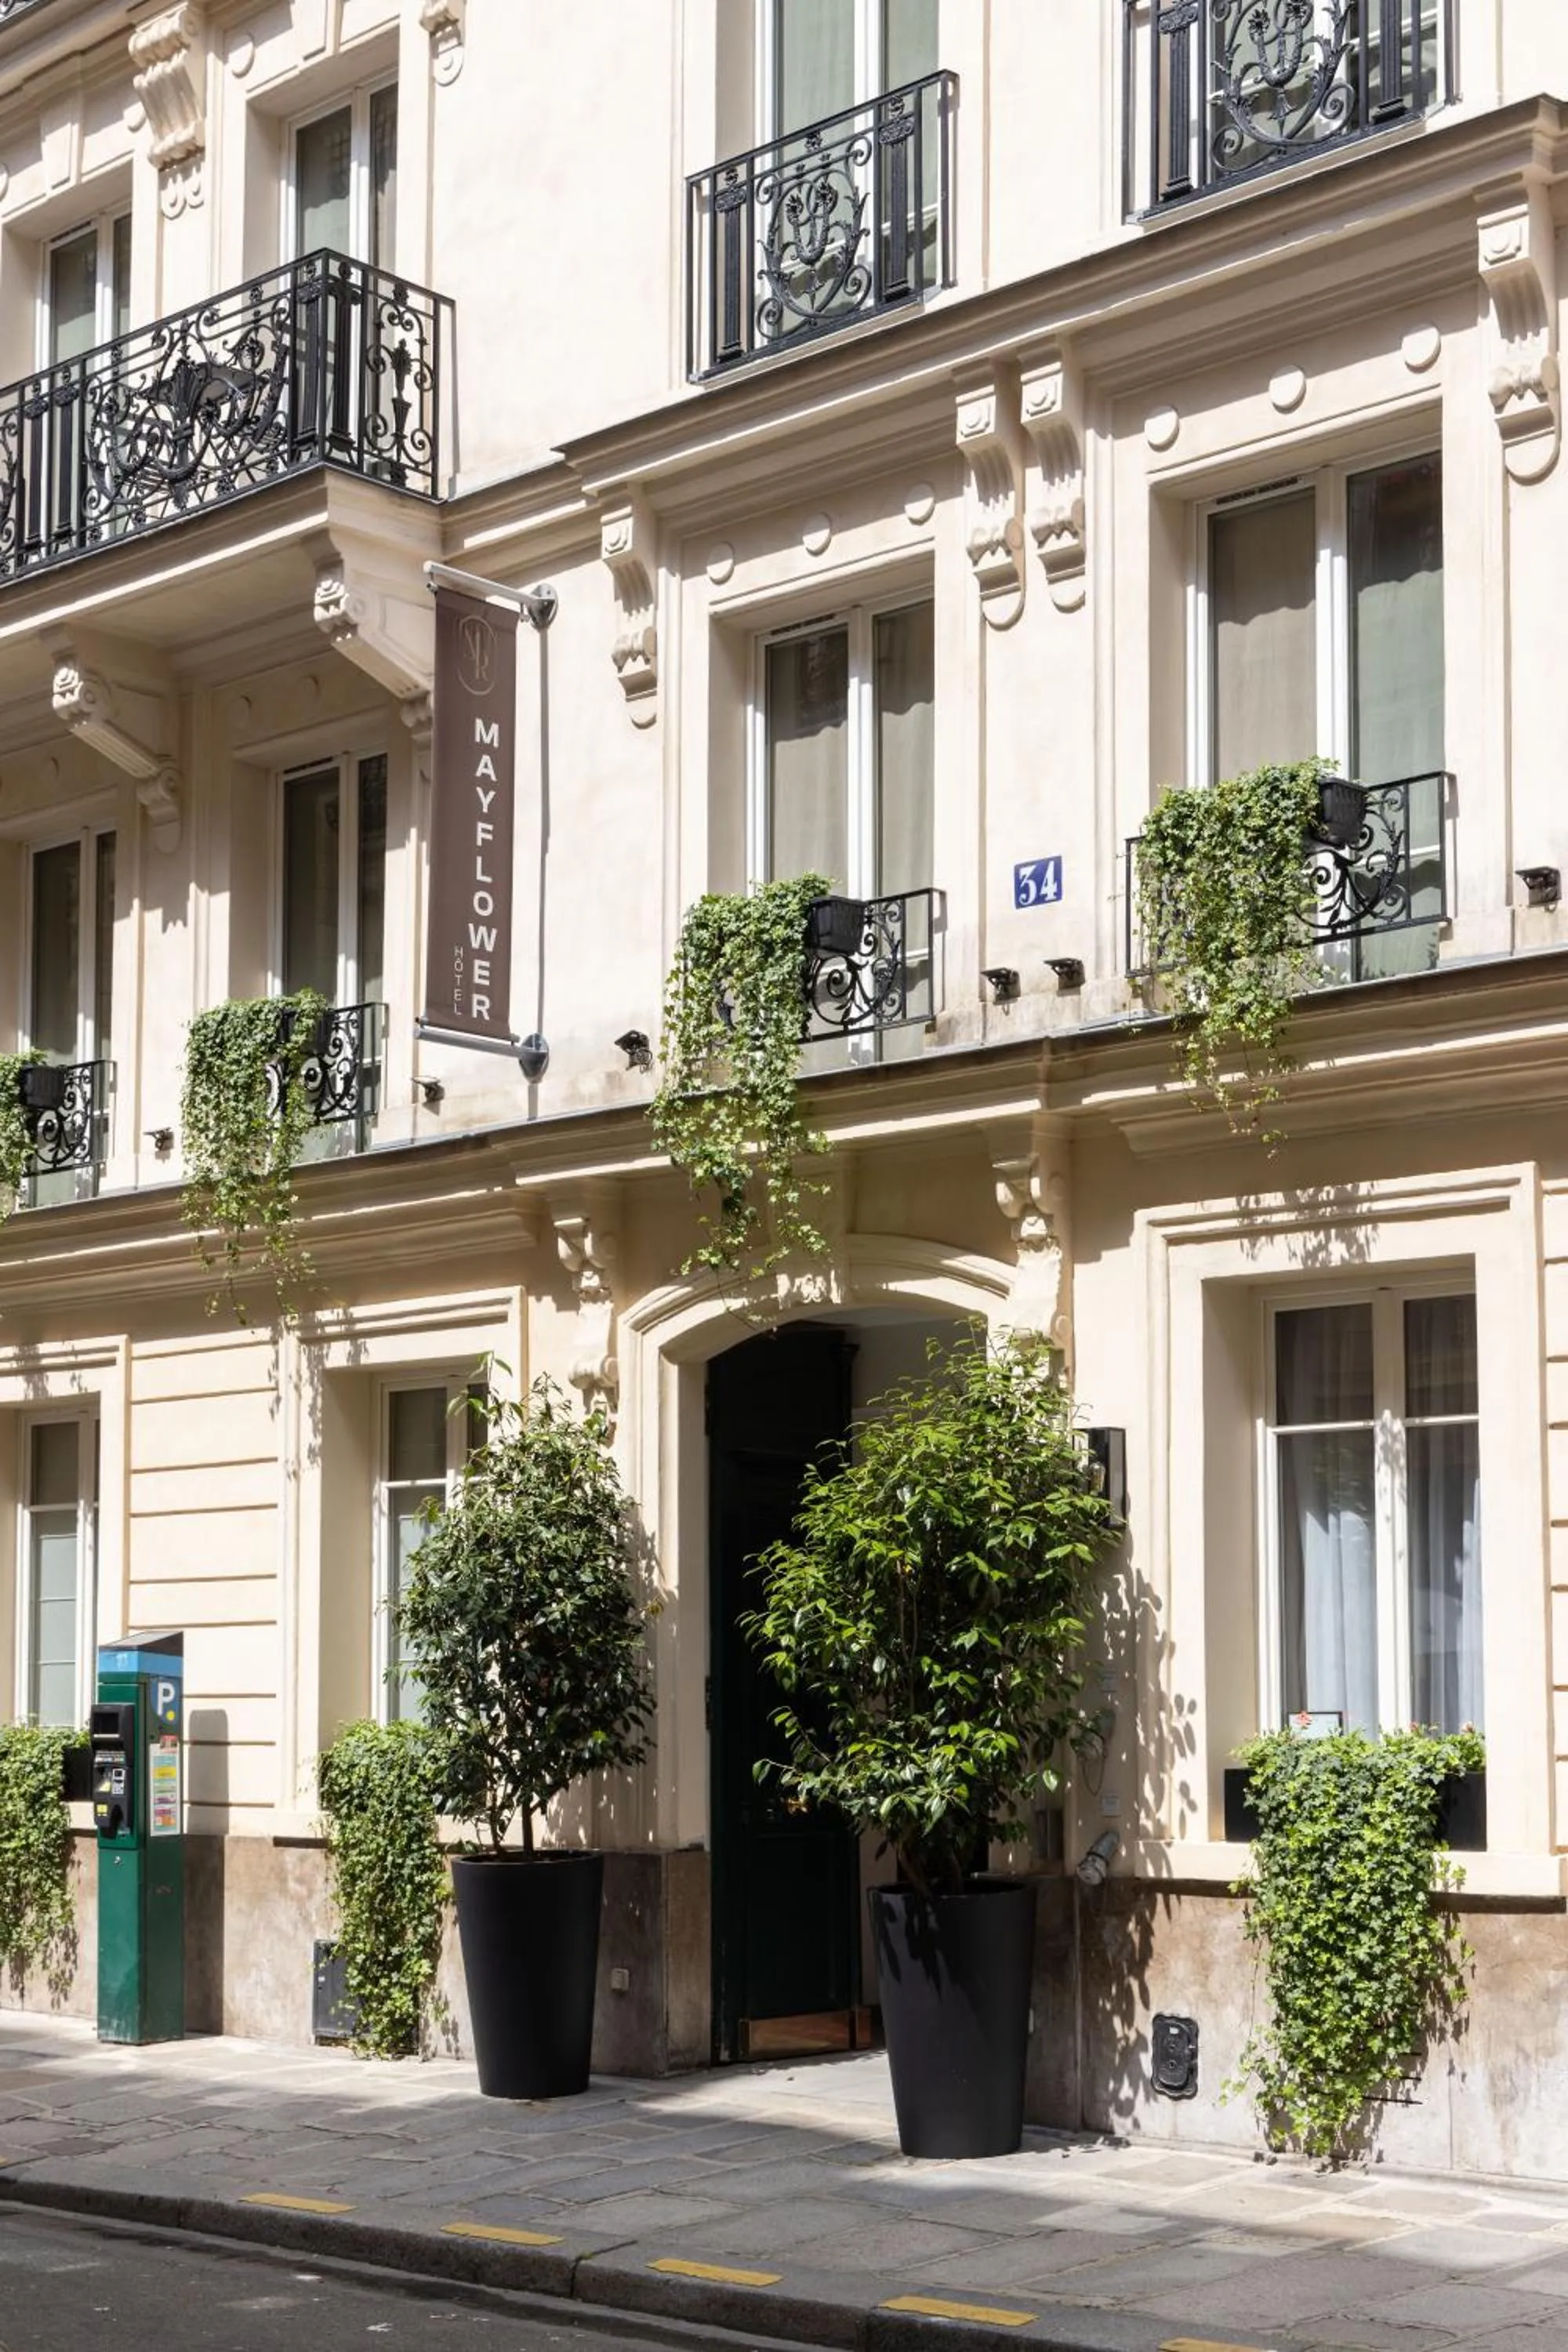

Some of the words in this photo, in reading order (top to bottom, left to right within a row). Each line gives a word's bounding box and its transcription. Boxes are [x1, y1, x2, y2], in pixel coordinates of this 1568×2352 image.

[468, 717, 499, 1021] MAYFLOWER
[1019, 860, 1057, 905] 34
[454, 945, 463, 1015] HÔTEL
[158, 1682, 175, 1716] P
